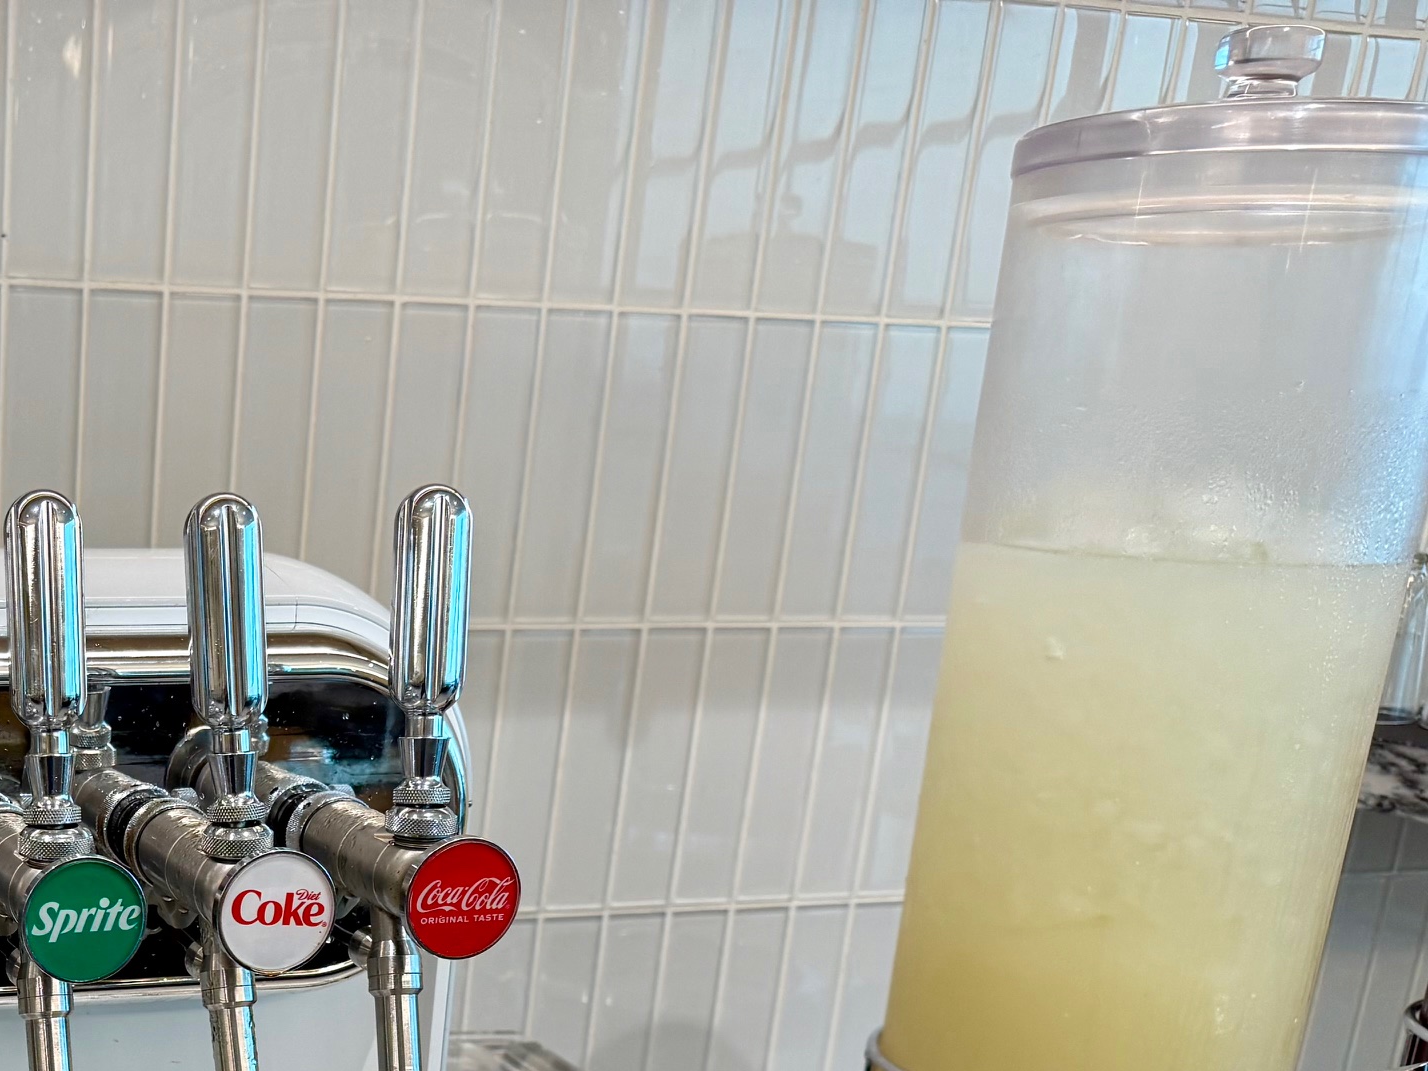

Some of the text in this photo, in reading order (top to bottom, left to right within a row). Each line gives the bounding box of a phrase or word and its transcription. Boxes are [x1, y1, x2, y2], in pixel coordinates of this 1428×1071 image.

[296, 888, 321, 901] Diet
[31, 897, 141, 943] Sprite
[231, 889, 325, 927] Coke
[420, 913, 504, 925] ORIGINAL TASTE
